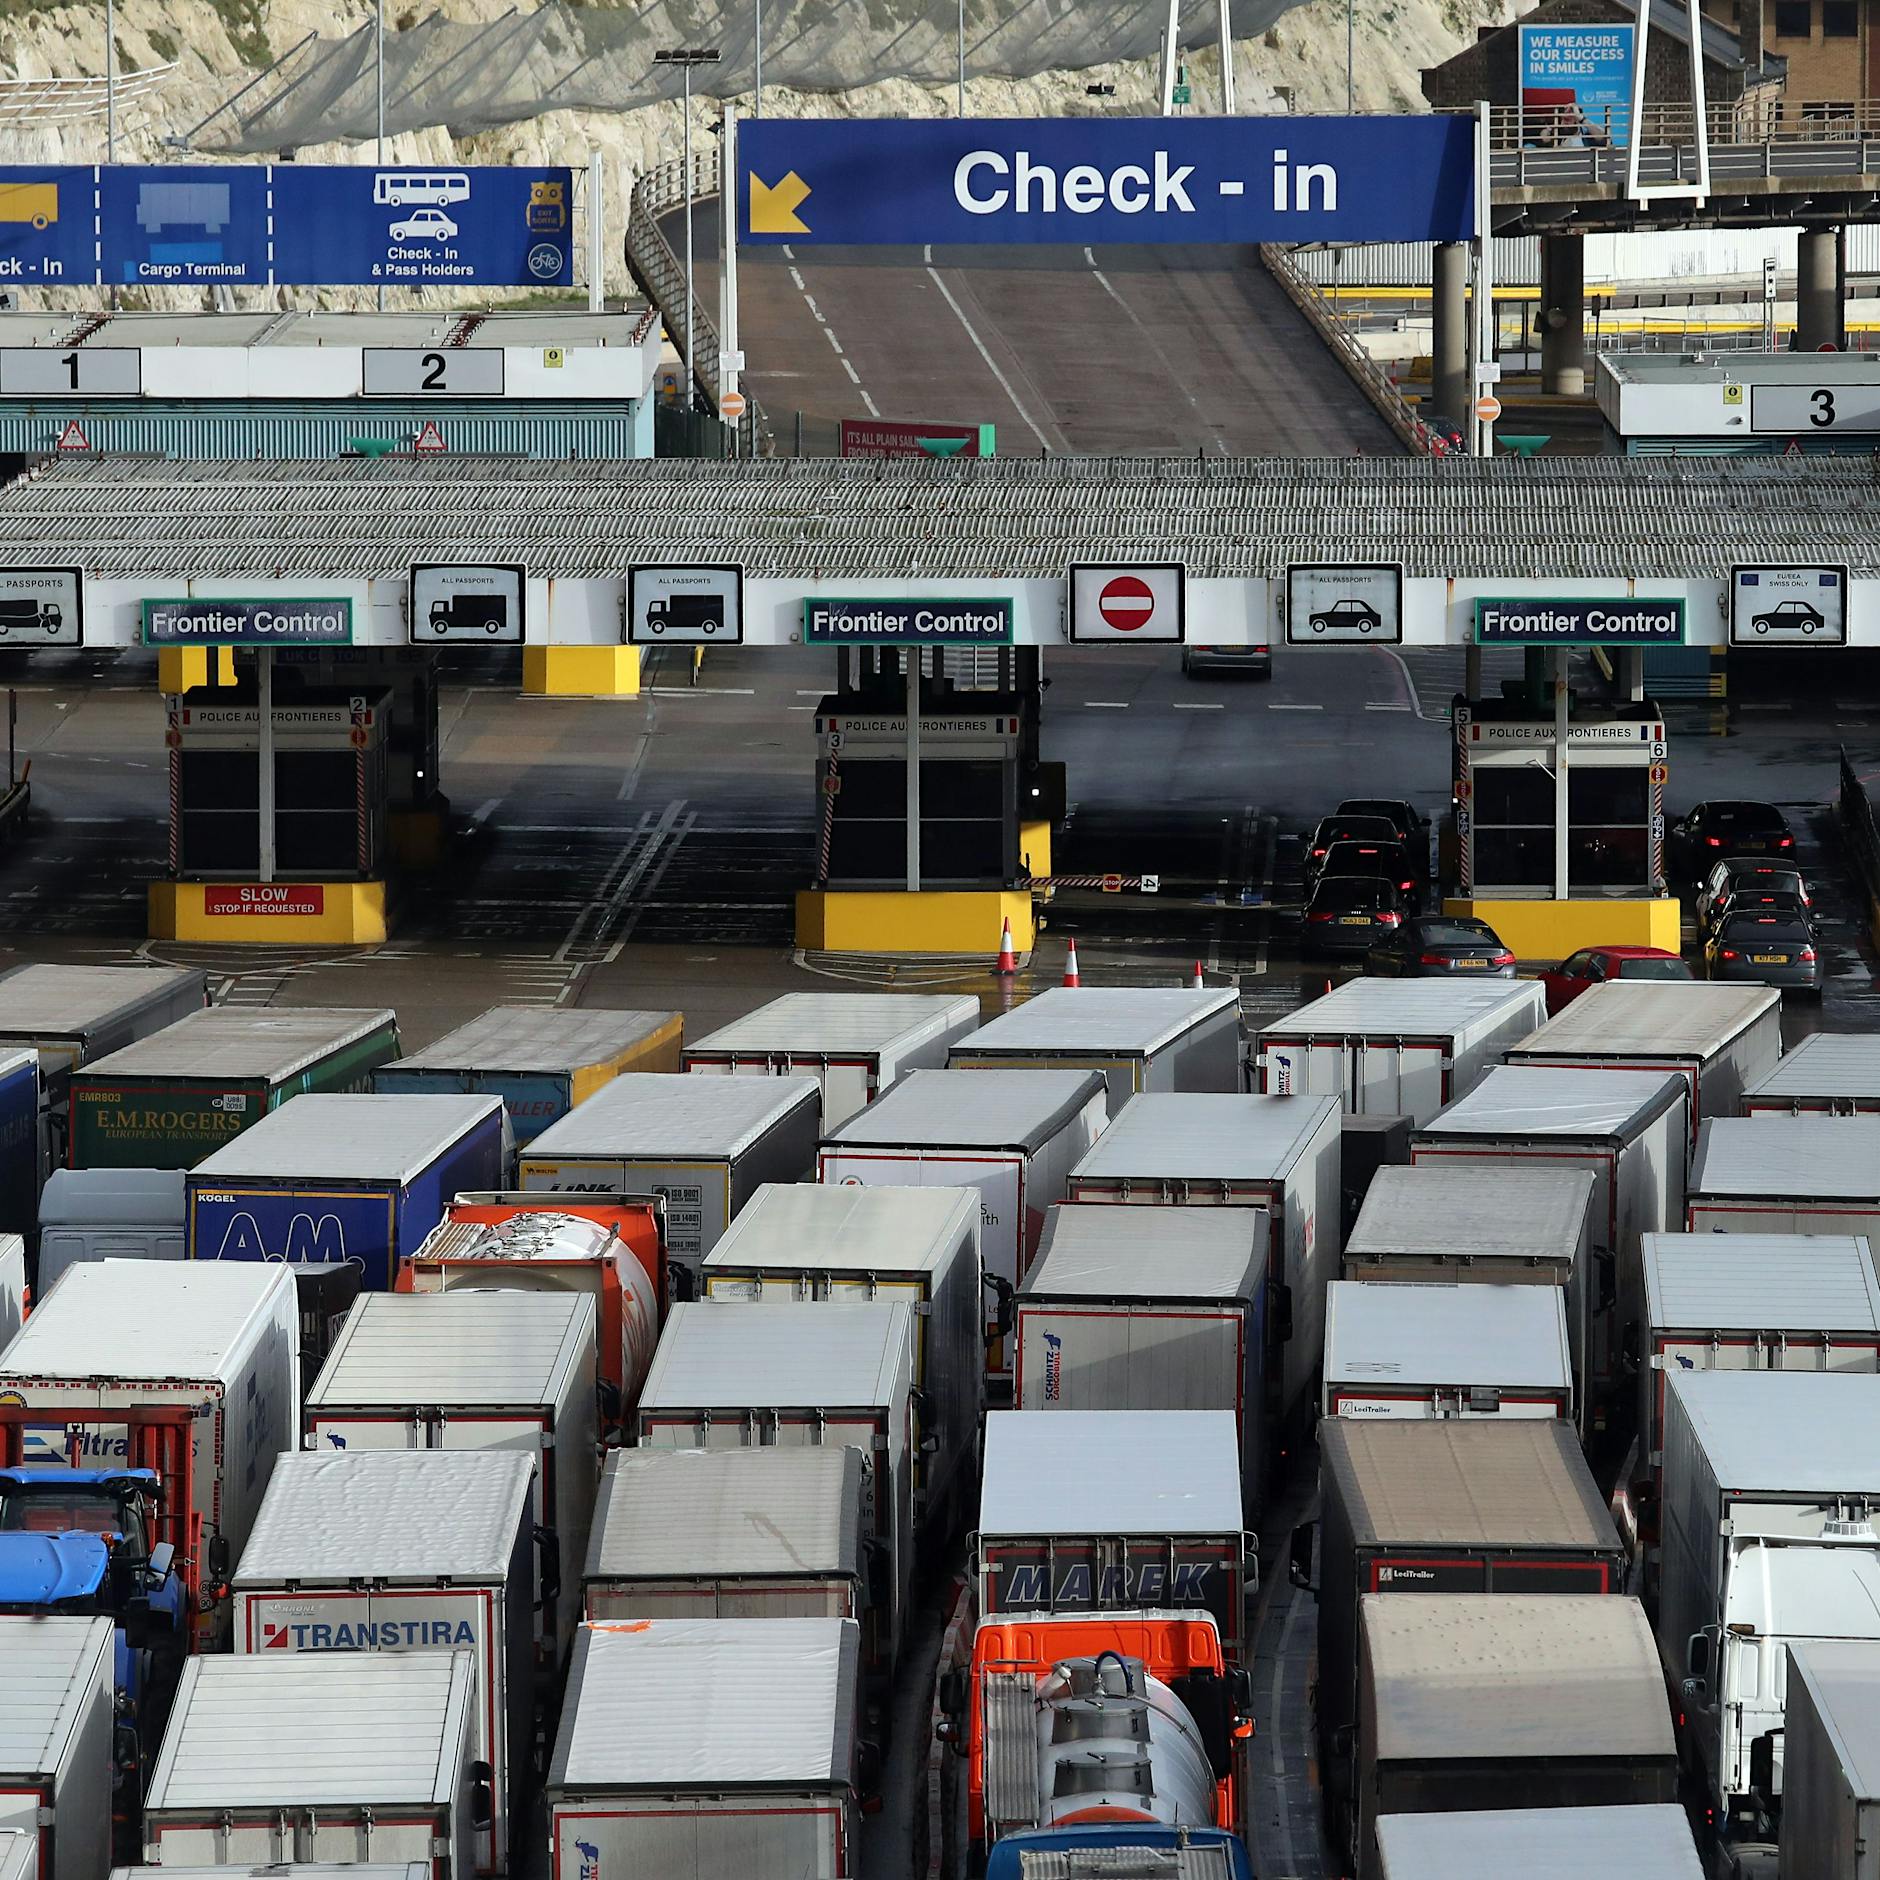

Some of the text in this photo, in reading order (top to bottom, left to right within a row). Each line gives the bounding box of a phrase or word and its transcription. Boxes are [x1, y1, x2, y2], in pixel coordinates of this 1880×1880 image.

[1530, 35, 1619, 47] WE MEASURE
[1530, 49, 1625, 60] OUR SUCCESS
[1530, 62, 1595, 73] IN SMILES
[953, 149, 1337, 214] Check - in
[387, 247, 433, 260] Check
[445, 247, 458, 260] In
[43, 257, 63, 275] In
[139, 262, 246, 278] Cargo Terminal
[371, 264, 474, 276] & Pass Holders
[61, 352, 78, 389] 1
[420, 353, 447, 390] 2
[1809, 389, 1836, 427] 3
[862, 432, 872, 445] ALL
[876, 433, 898, 447] PLAIN
[900, 435, 928, 448] SAILIN
[6, 579, 63, 588] PASSPORTS
[152, 611, 343, 634] Frontier Control
[813, 611, 1004, 632] Frontier Control
[1484, 610, 1676, 632] Frontier Control
[171, 699, 177, 711] 1
[353, 699, 362, 711] 2
[200, 712, 342, 722] POLICE AU FRONTIERES
[1458, 710, 1467, 722] 5
[846, 721, 887, 731] POLICE
[890, 721, 908, 731] AU
[1489, 729, 1531, 738] POLICE
[1567, 729, 1632, 738] RONTIERES
[830, 734, 840, 747] 3
[1653, 744, 1664, 757] 6
[240, 888, 288, 902] SLOW
[213, 904, 315, 913] STOP IF REQUESTED
[79, 1092, 121, 1103] EMR803
[96, 1110, 241, 1131] E.M.ROGERS
[105, 1130, 229, 1141] EUROPEAN TRANSPORT
[1045, 1351, 1061, 1401] SCHMITZ CARGOBULL
[1006, 1562, 1213, 1603] MAREK
[291, 1620, 475, 1648] TRANSTIRA
